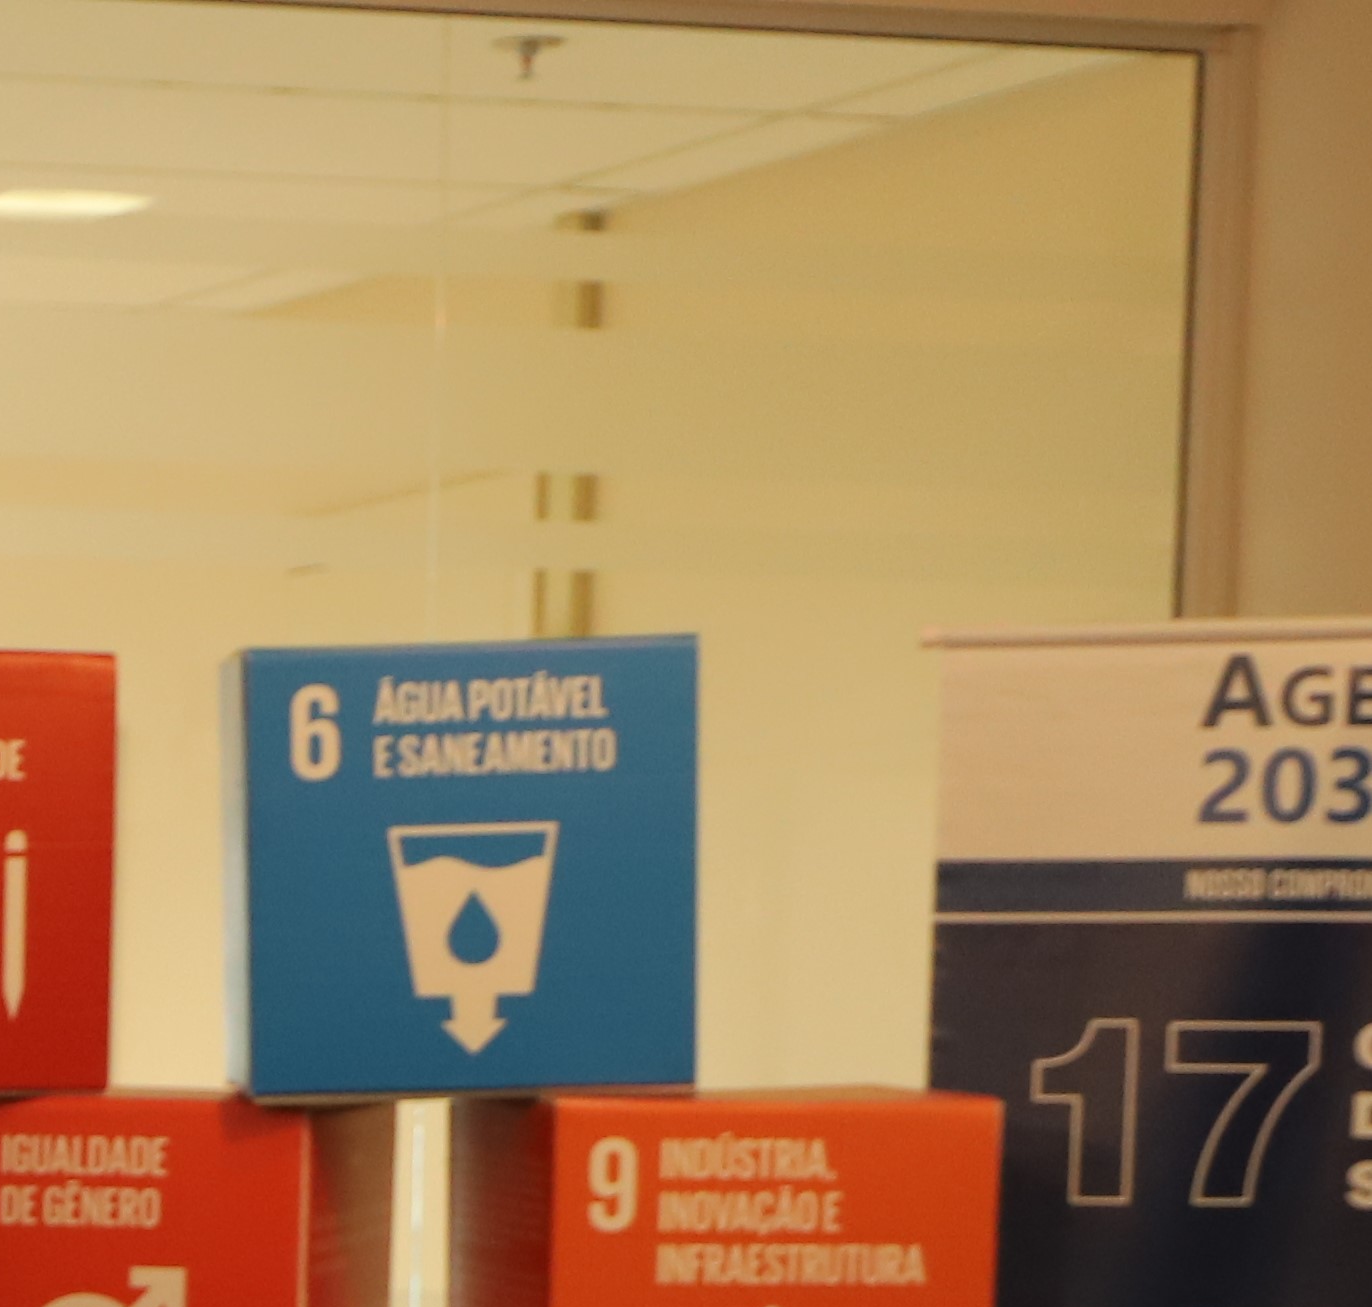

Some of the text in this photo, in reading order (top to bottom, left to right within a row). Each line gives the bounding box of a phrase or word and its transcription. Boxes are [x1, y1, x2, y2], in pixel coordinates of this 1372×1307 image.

[372, 670, 610, 725] ÁGUA POTÁVEL
[1202, 653, 1372, 728] AGE
[288, 682, 342, 783] 6
[372, 727, 618, 779] E SANEAMENTO
[1197, 746, 1372, 826] 203
[1029, 1017, 1324, 1208] 17
[0, 1134, 170, 1177] IGUALDADE
[42, 1179, 162, 1229] GÊNERO
[587, 1135, 639, 1233] 9
[657, 1185, 844, 1235] INOVAÇÃO E
[656, 1243, 927, 1286] INFRAESTRUTURA
